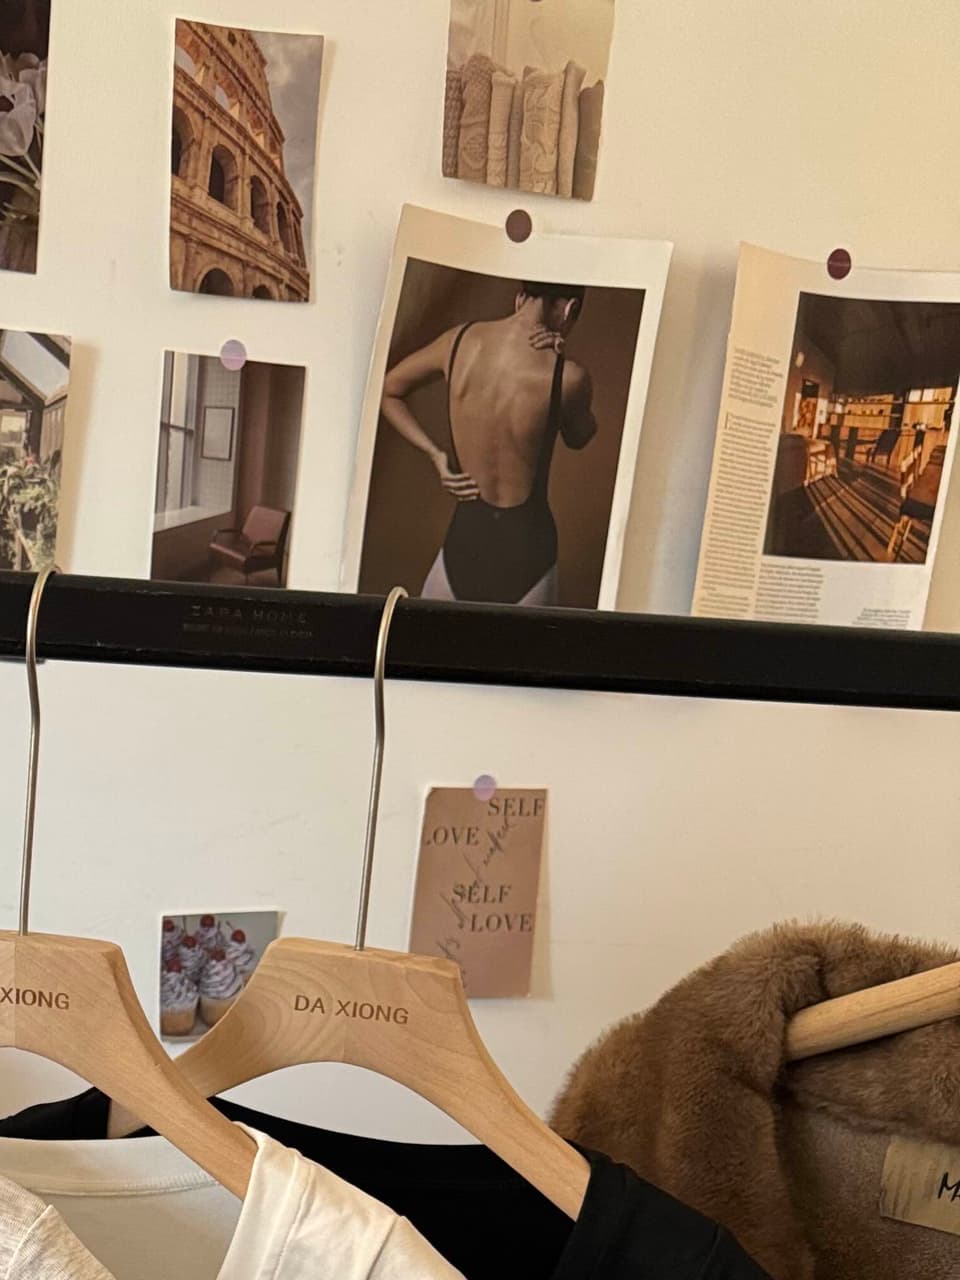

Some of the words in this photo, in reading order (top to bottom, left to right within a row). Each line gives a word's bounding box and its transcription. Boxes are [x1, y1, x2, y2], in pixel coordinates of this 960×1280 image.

[426, 826, 480, 846] OVE
[451, 883, 512, 904] SELF
[470, 913, 532, 933] LOVE
[0, 986, 70, 1010] XIONG
[295, 995, 326, 1014] DA
[335, 1002, 409, 1025] XIONG
